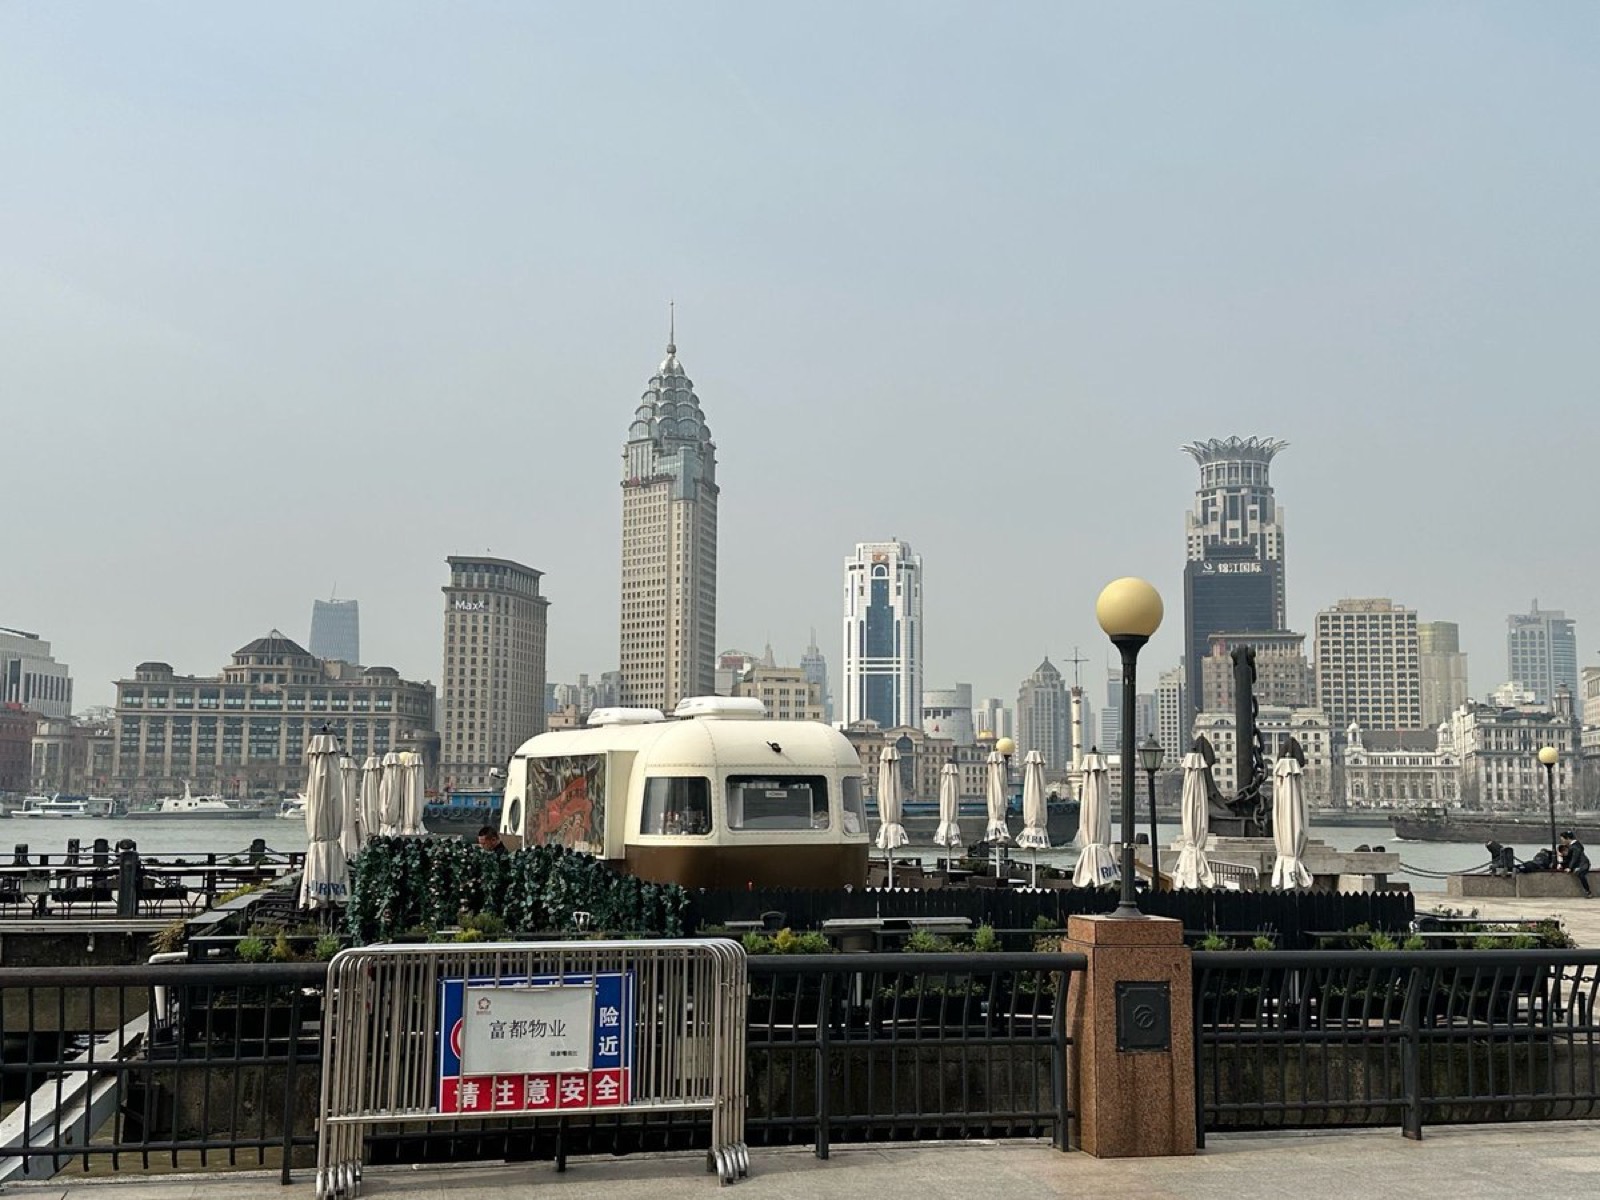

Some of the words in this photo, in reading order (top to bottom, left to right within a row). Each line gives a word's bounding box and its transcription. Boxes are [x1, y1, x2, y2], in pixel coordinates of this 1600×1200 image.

[489, 1019, 566, 1040] 富都物业
[453, 1074, 620, 1109] 请注意安全
